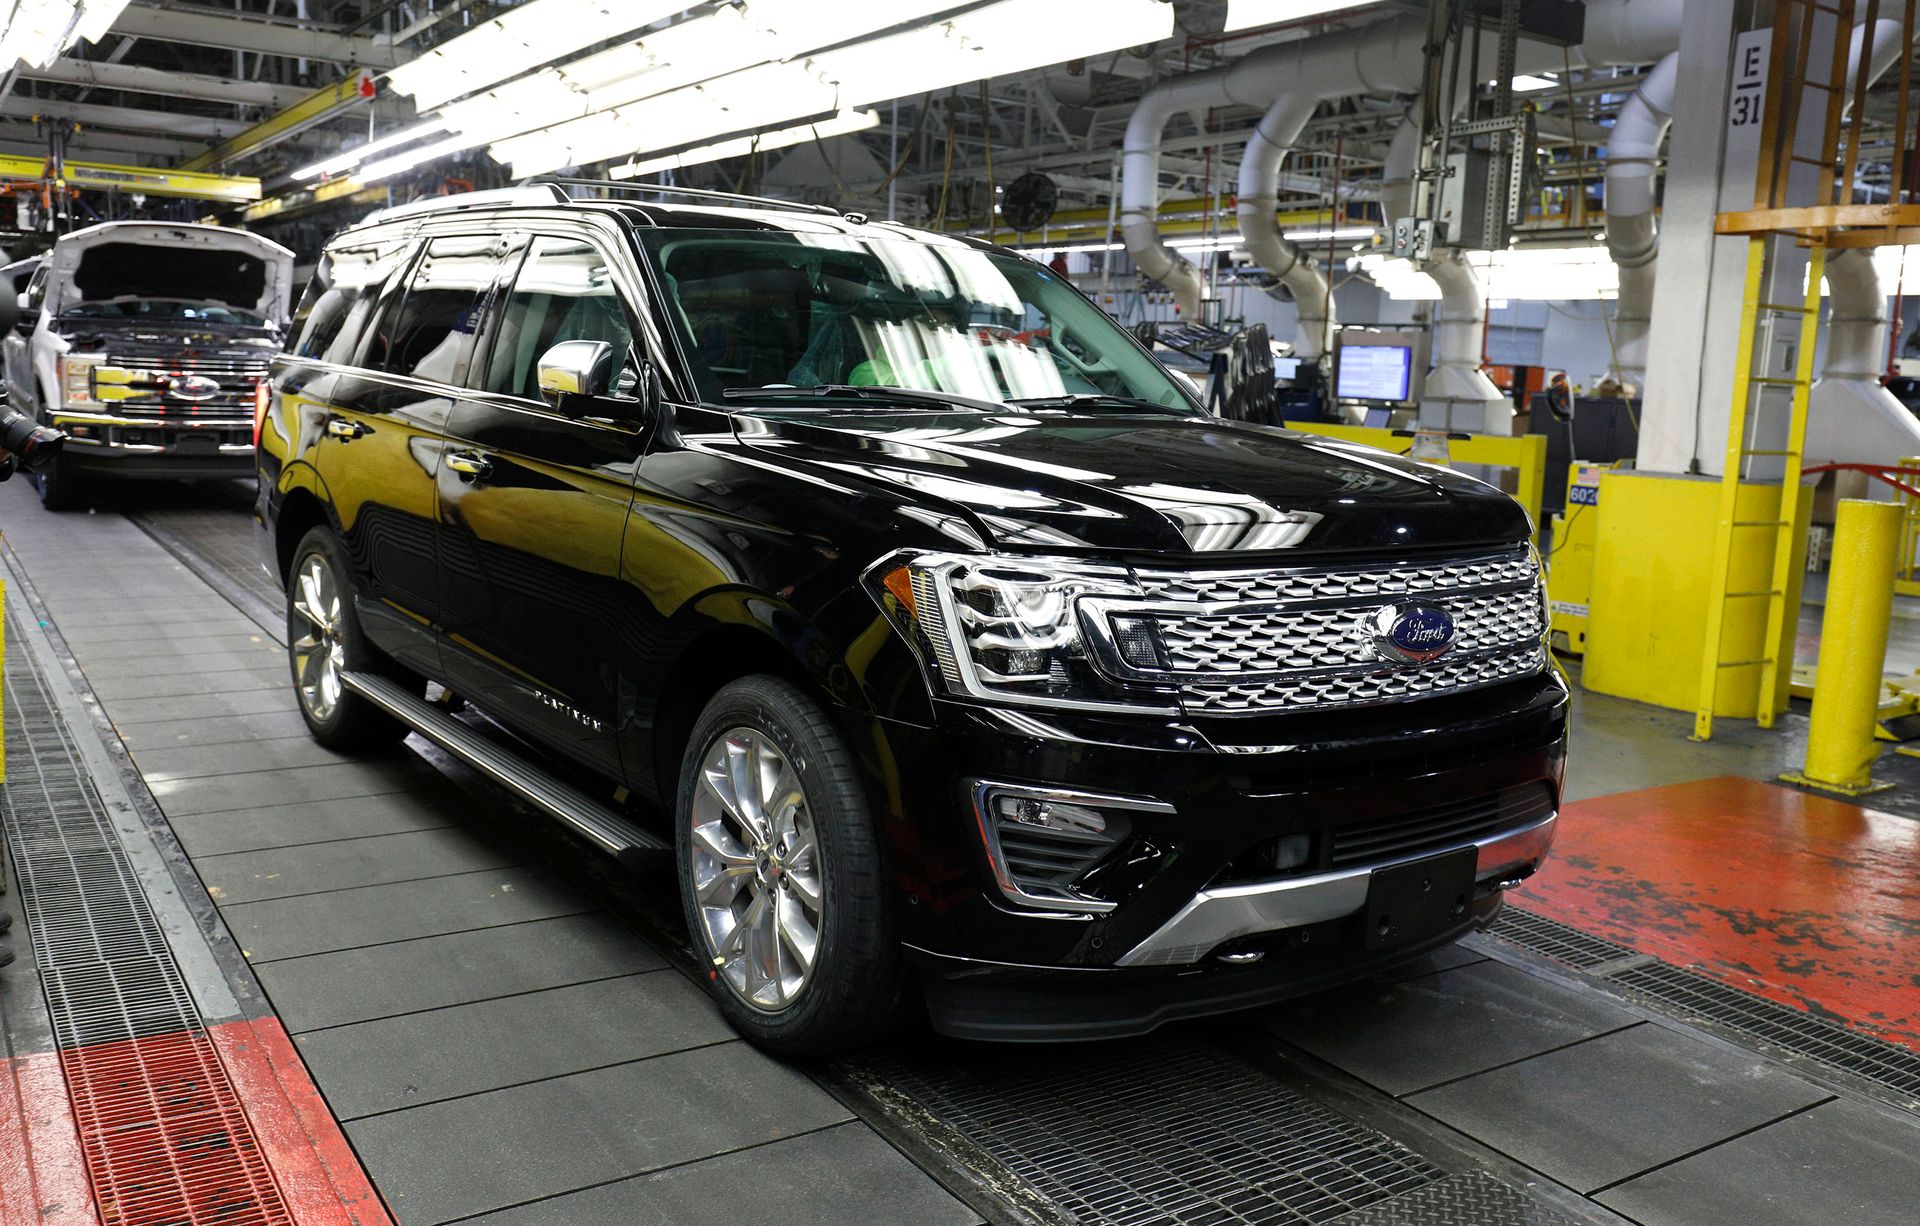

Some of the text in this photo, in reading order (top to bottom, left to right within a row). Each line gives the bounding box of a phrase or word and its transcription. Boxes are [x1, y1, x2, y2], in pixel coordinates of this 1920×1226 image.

[1744, 46, 1761, 78] E
[1732, 94, 1760, 126] 31
[1571, 486, 1599, 503] 602
[1406, 619, 1447, 643] Ford
[535, 690, 602, 733] PLATINUM
